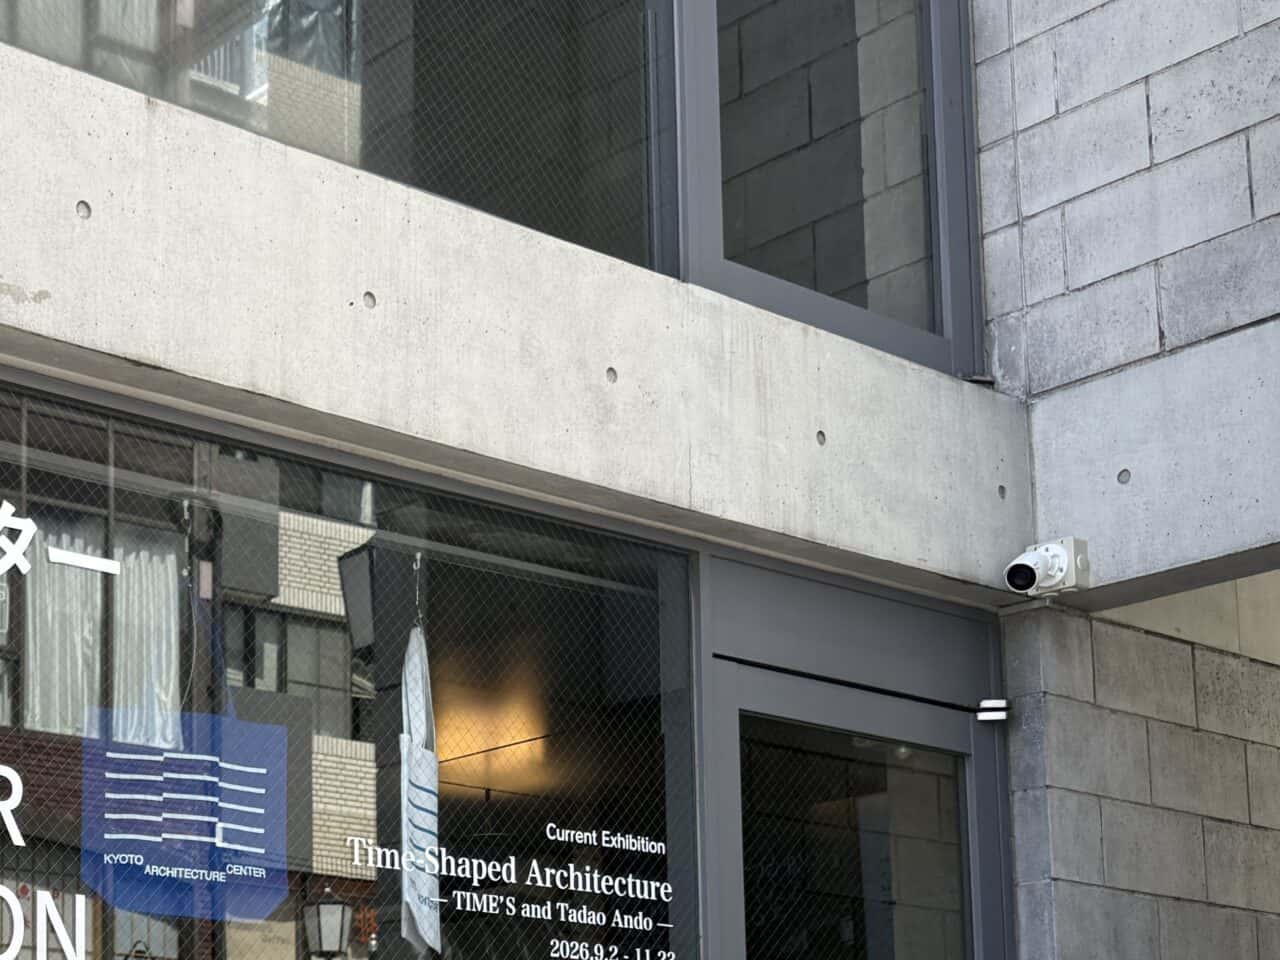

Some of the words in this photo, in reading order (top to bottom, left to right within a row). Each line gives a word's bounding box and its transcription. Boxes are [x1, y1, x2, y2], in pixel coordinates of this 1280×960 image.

[546, 822, 598, 846] Current
[601, 830, 666, 855] Exhibition
[103, 854, 144, 866] KYOTO
[144, 864, 226, 882] ARCHITECTURE
[226, 864, 266, 878] CENTER
[347, 836, 517, 887] Time-Shaped
[525, 859, 673, 902] Architecture
[452, 890, 516, 916] TIME'S
[521, 900, 552, 920] and
[556, 902, 607, 926] Tadao
[611, 909, 653, 931] Ando
